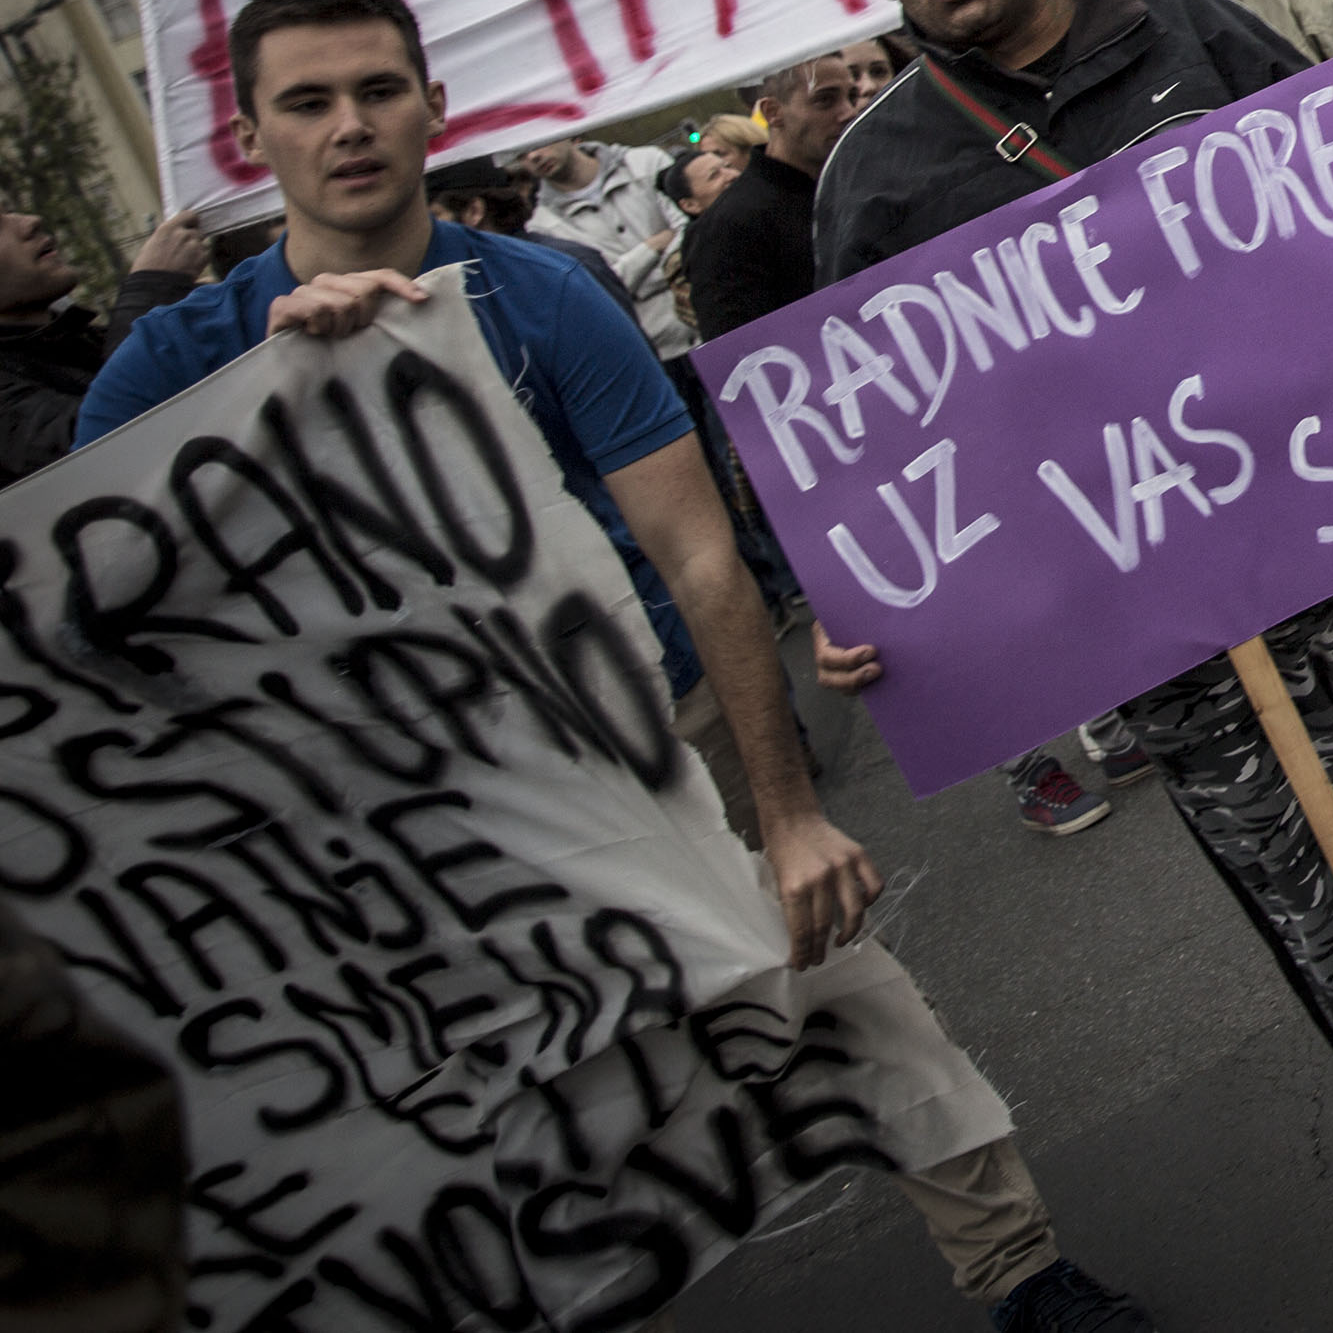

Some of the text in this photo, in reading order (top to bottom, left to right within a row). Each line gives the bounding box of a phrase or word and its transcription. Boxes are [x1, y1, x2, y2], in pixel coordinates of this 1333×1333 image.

[719, 194, 1145, 492] RADNICE
[826, 438, 1001, 609] UZ
[1036, 374, 1255, 573] VAS
